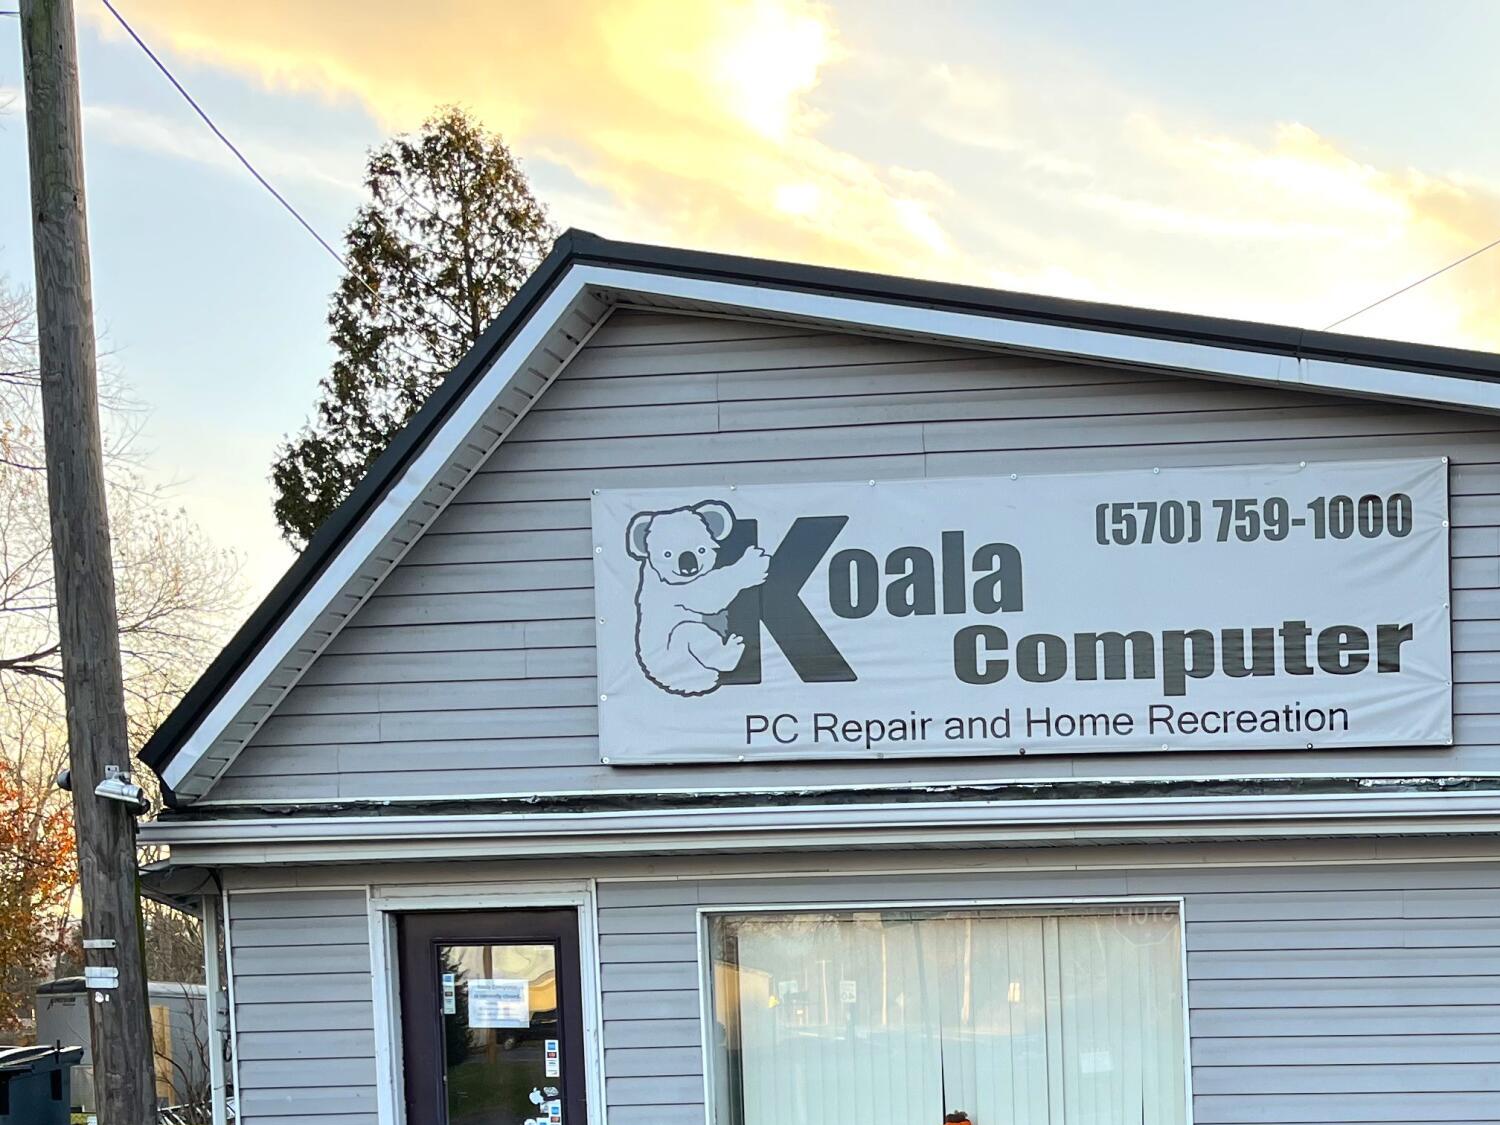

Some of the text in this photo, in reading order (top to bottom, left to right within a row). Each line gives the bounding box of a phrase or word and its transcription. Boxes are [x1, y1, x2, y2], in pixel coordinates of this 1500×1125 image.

[1095, 493, 1413, 546] (570) 759-1000
[714, 514, 1024, 686] Koala
[953, 620, 1413, 697] Computer
[745, 701, 1349, 749] PC Repair and Home Recreation
